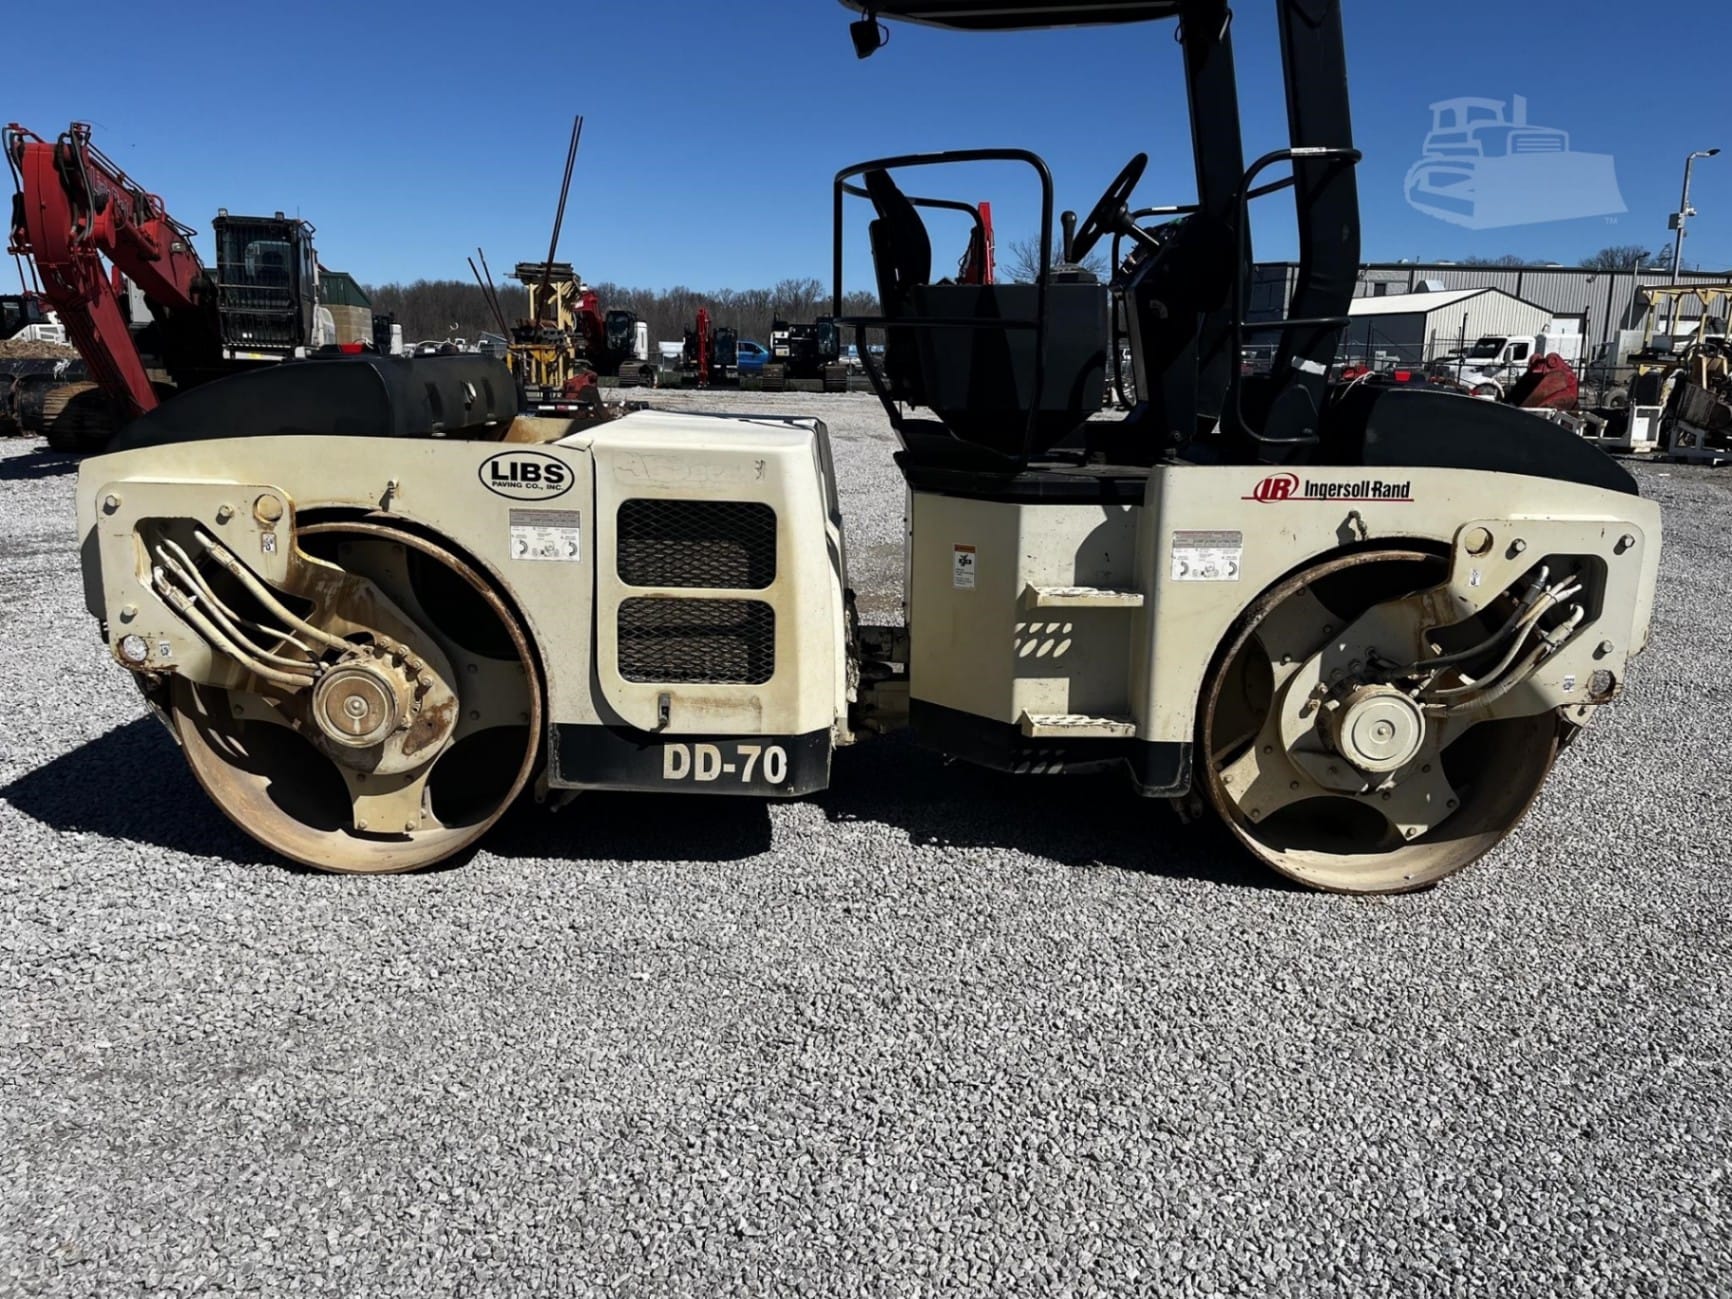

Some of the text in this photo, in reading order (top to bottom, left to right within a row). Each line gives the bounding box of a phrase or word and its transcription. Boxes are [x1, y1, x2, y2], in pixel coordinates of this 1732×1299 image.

[491, 461, 564, 483] LIBS
[525, 482, 543, 490] CO.,
[1260, 478, 1292, 500] IR
[663, 743, 787, 784] DD-70
